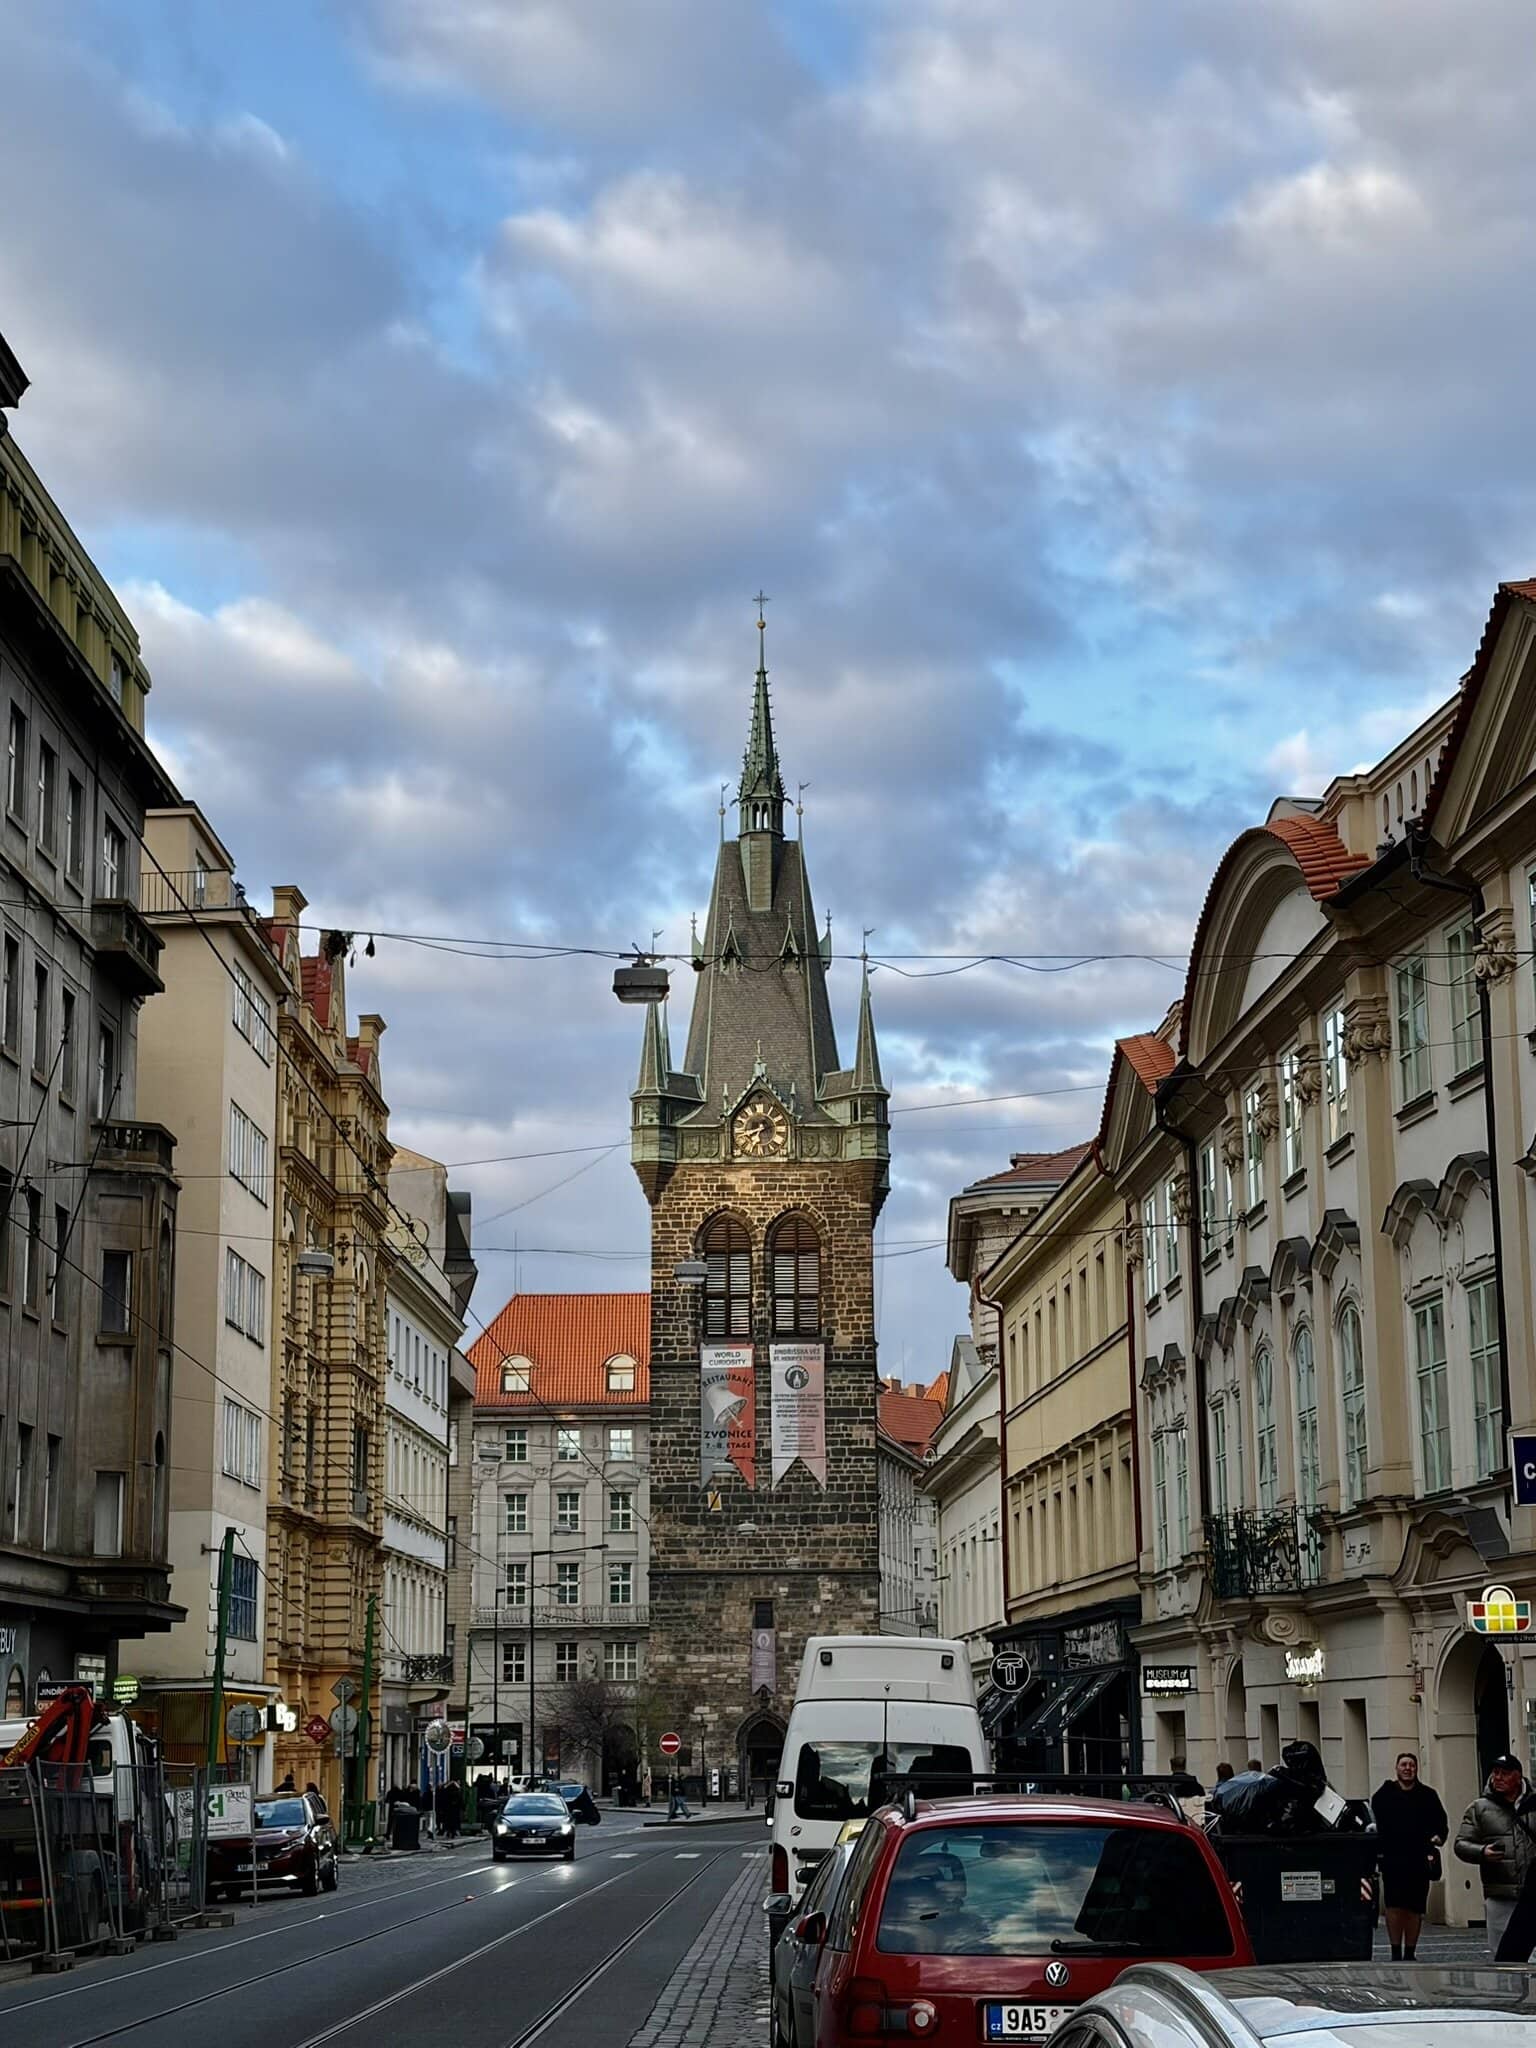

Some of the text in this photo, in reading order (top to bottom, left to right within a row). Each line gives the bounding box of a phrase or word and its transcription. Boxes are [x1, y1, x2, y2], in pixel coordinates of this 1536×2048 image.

[714, 1351, 741, 1359] WORLD
[702, 1373, 753, 1387] RESTAURANT
[704, 1430, 752, 1439] ZVONICE
[0, 1628, 16, 1654] BUY
[1146, 1668, 1188, 1680] MUSEUM of
[1007, 2008, 1046, 2031] 9A5
[990, 2023, 1001, 2031] CZ
